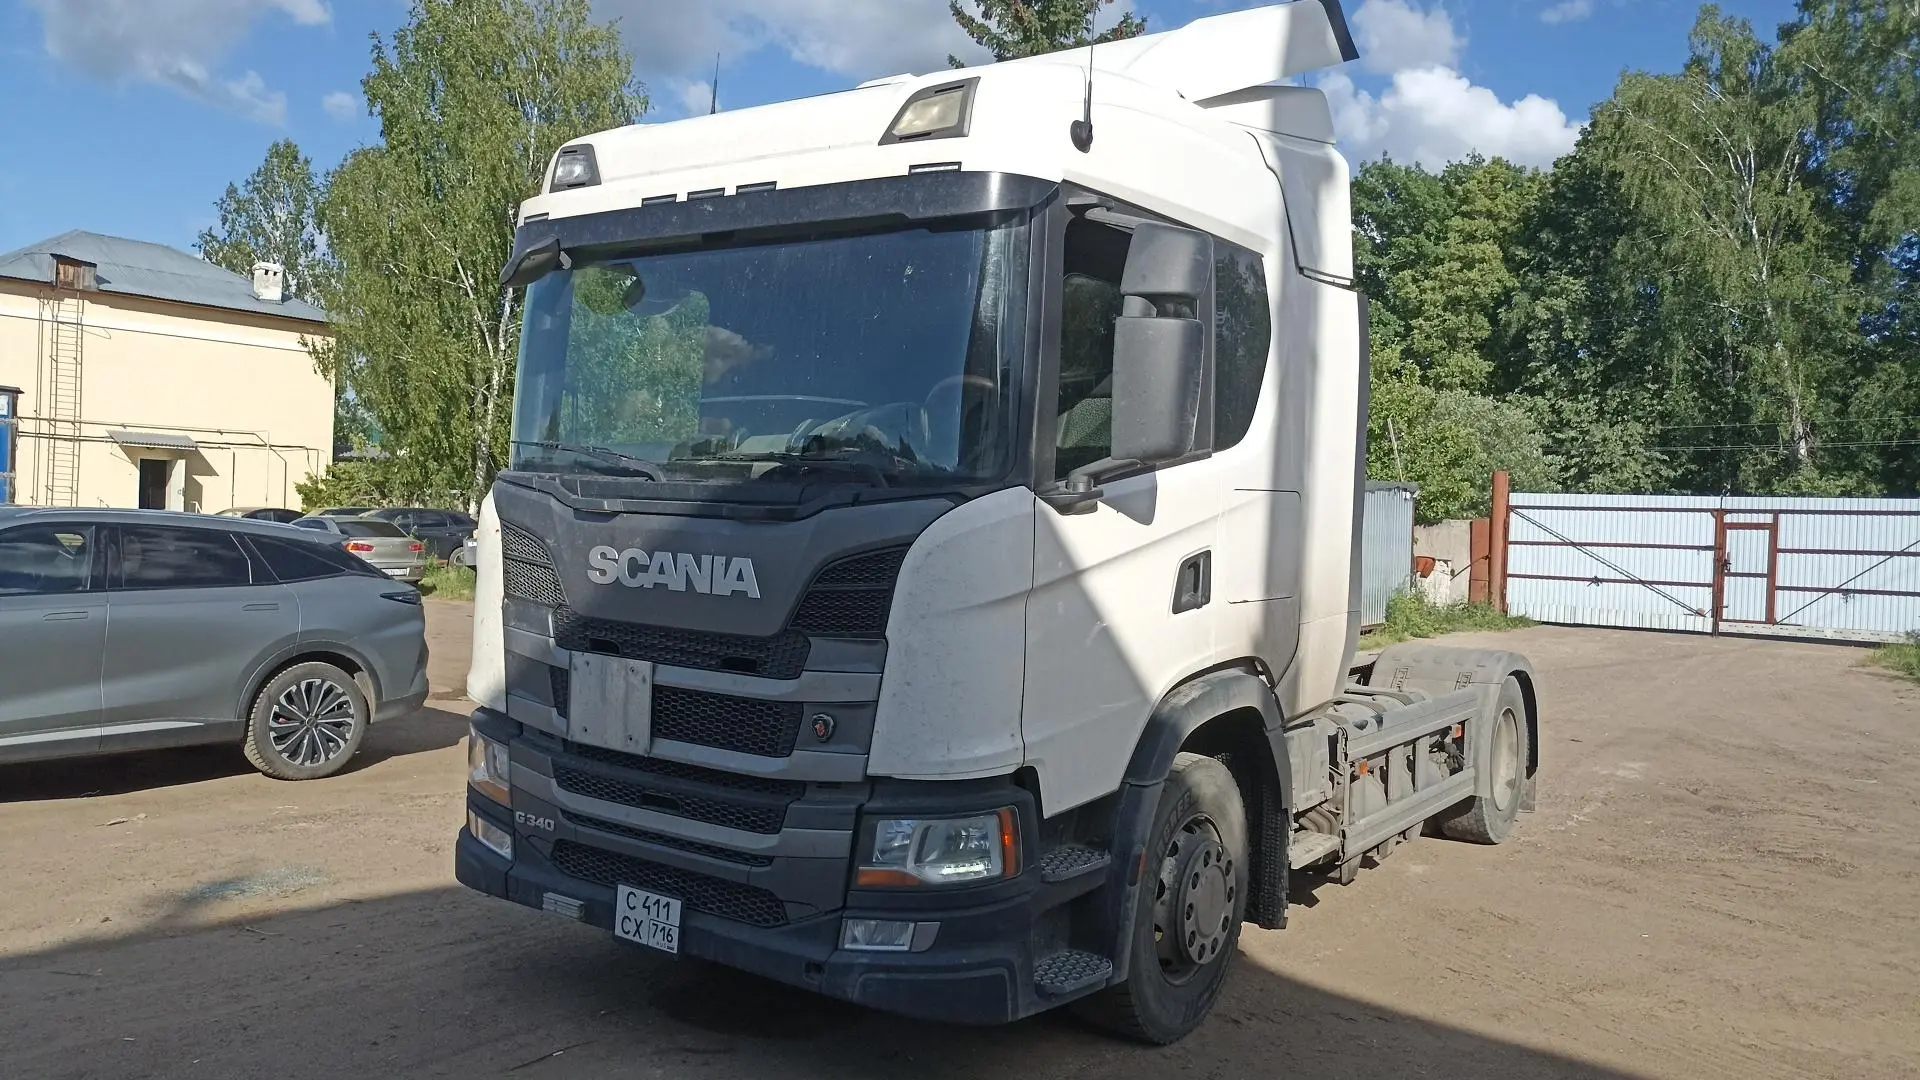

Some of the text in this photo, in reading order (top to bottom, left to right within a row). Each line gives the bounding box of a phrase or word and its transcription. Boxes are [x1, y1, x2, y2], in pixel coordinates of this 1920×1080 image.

[587, 545, 761, 599] SCANIA
[642, 895, 671, 922] 411
[651, 922, 674, 944] 716
